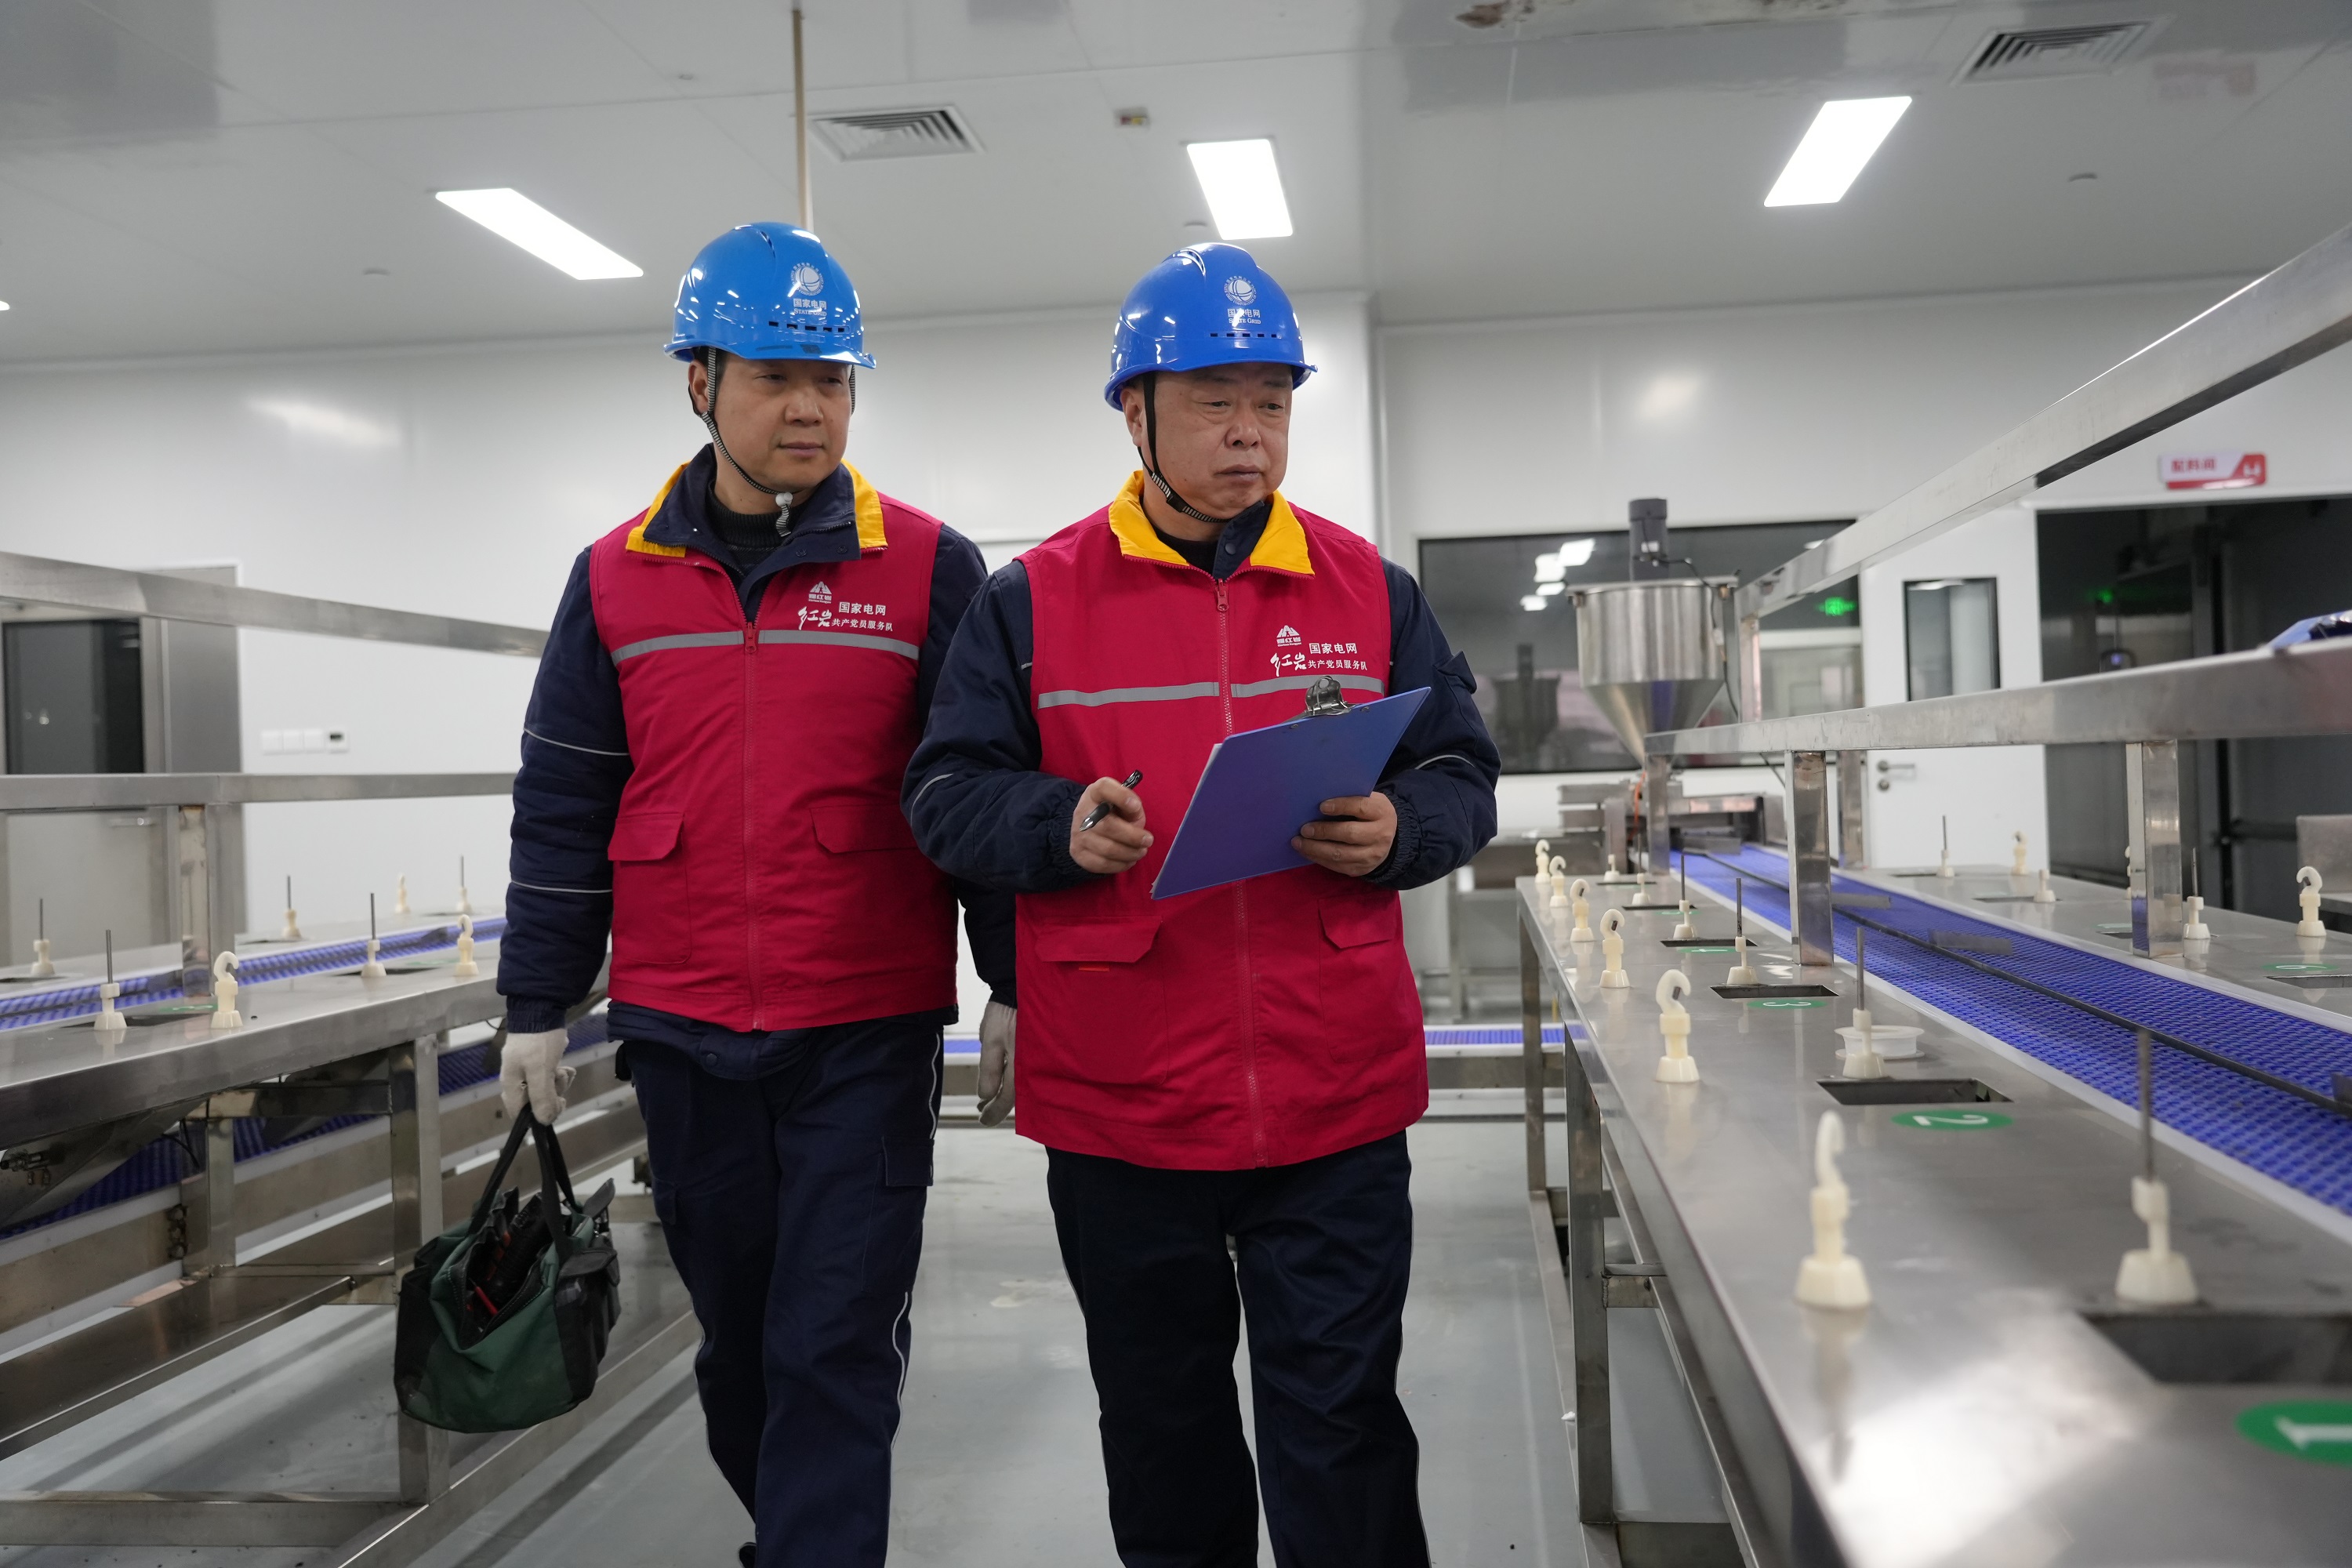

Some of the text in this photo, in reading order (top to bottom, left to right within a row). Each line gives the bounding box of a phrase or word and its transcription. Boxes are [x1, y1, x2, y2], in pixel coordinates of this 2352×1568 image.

[793, 299, 826, 310] 国家电网
[1228, 309, 1260, 318] 国电网
[838, 601, 886, 616] 国家电网
[832, 619, 893, 631] 共产党员服务队
[1308, 643, 1358, 655] 国家电网
[1308, 659, 1367, 670] 共产党员服务队
[1912, 1114, 1989, 1126] 2
